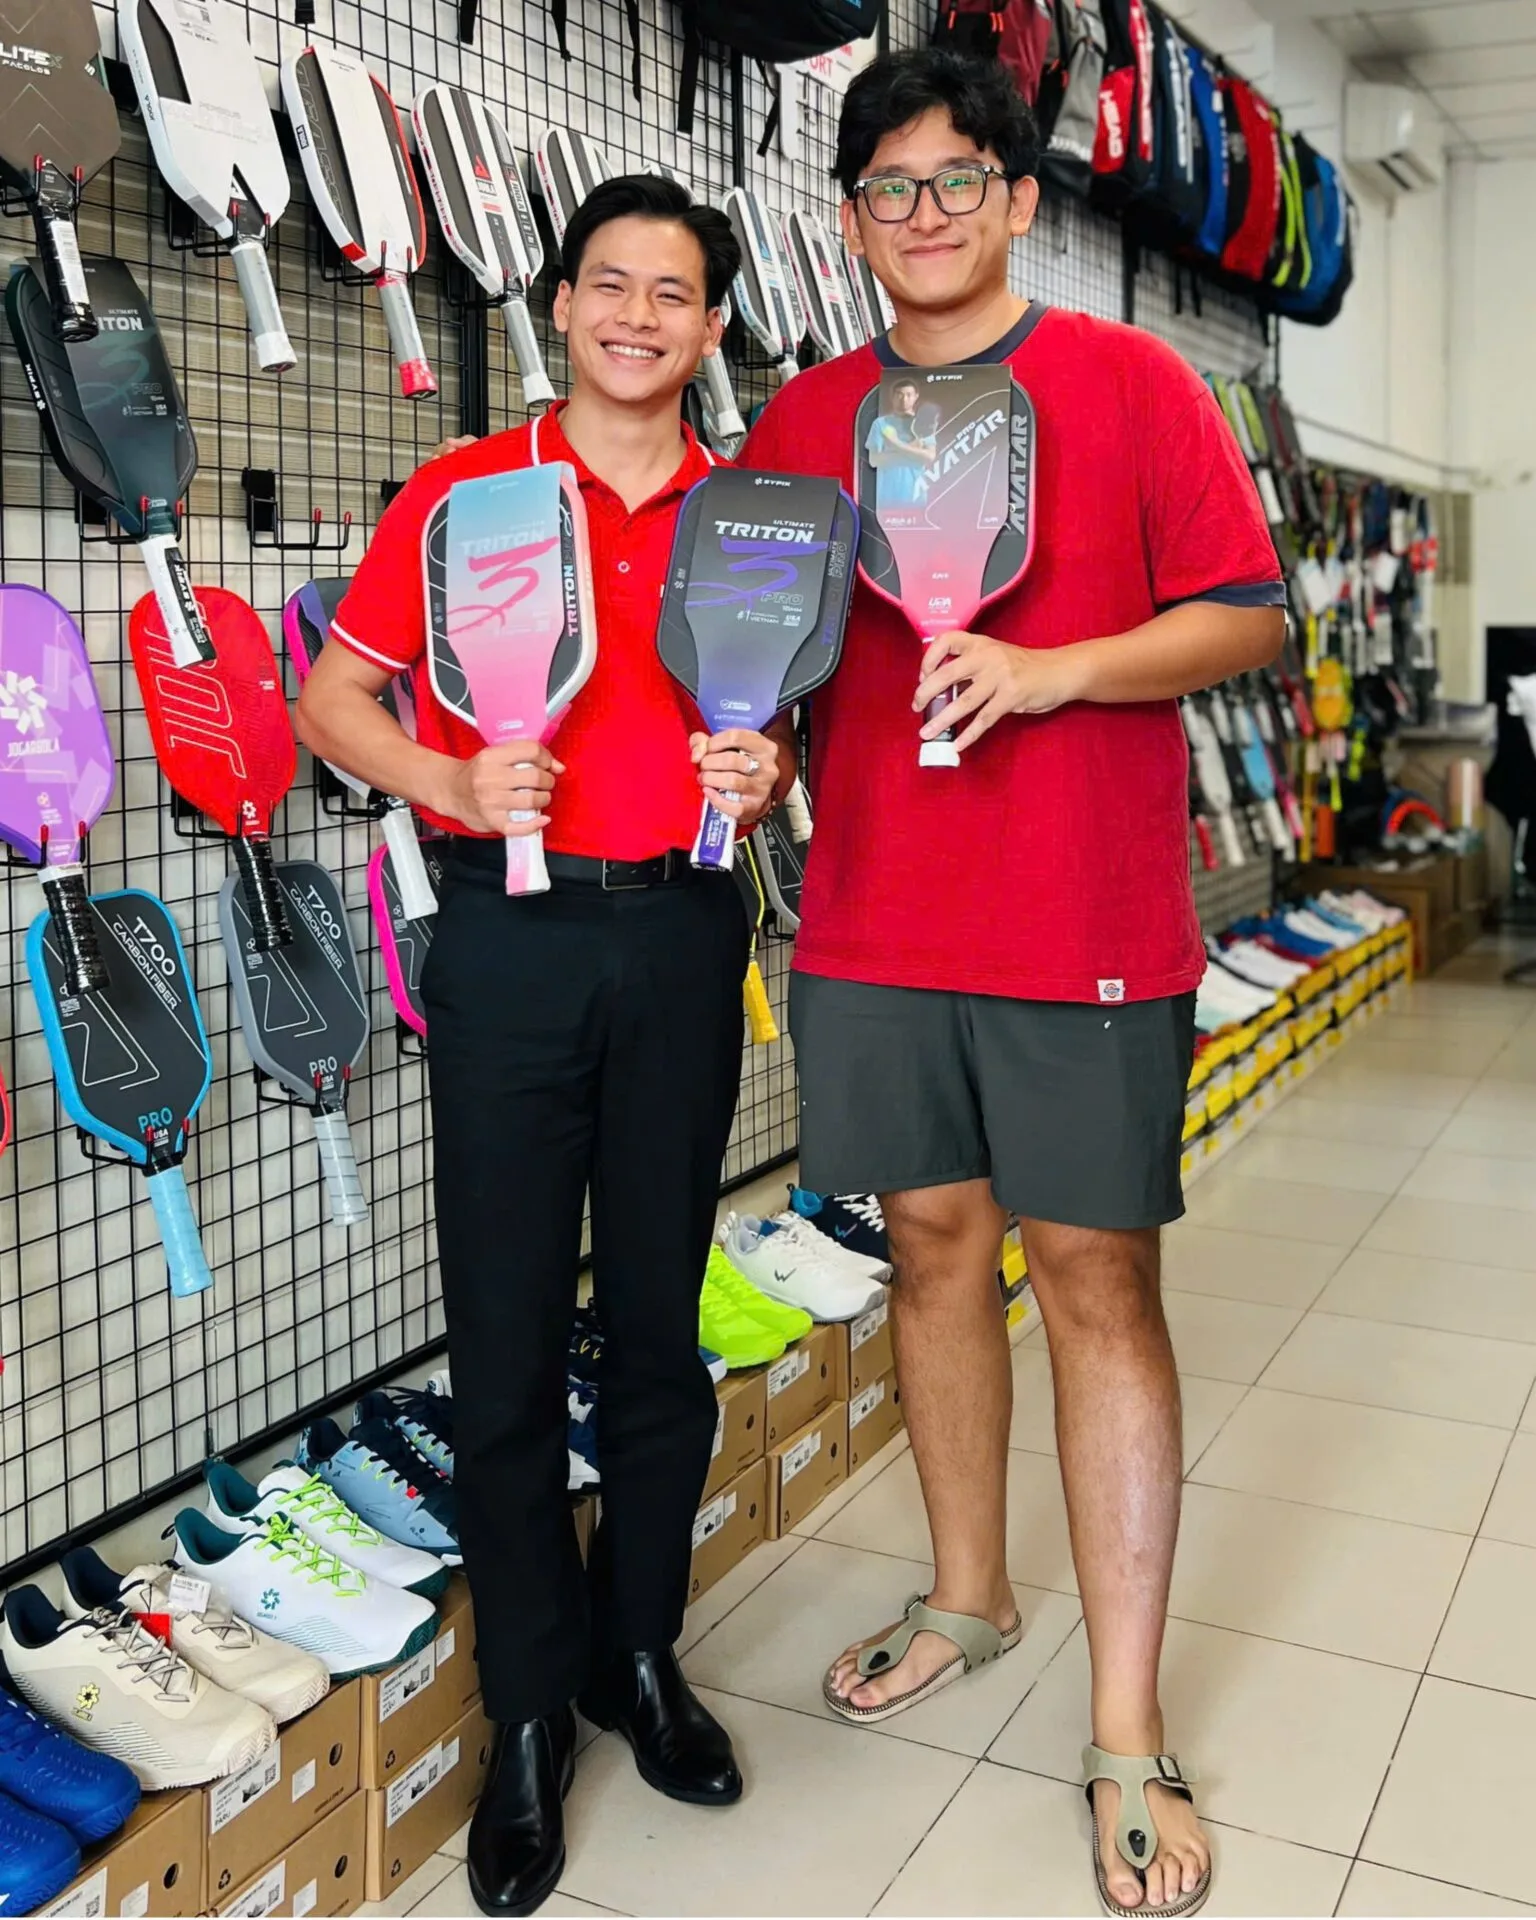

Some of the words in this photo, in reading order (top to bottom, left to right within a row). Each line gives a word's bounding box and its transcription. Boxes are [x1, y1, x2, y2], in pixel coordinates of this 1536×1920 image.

[99, 317, 144, 331] ITON
[912, 409, 1008, 503] AVATAR
[763, 479, 791, 487] SYPIK
[1009, 414, 1028, 535] AVATAR
[714, 520, 814, 544] TRITON
[773, 519, 816, 528] ULTIMATE
[460, 528, 546, 556] TRITON
[564, 564, 579, 637] TRITON
[760, 590, 804, 605] PRO
[305, 884, 341, 940] T700
[290, 888, 323, 938] CARBON
[320, 936, 342, 970] FIBER
[133, 916, 176, 976] T700
[113, 922, 153, 975] CARBON
[150, 973, 178, 1010] FIBER
[309, 1056, 338, 1078] PRO
[138, 1107, 173, 1134] PRO
[154, 1128, 169, 1139] USA
